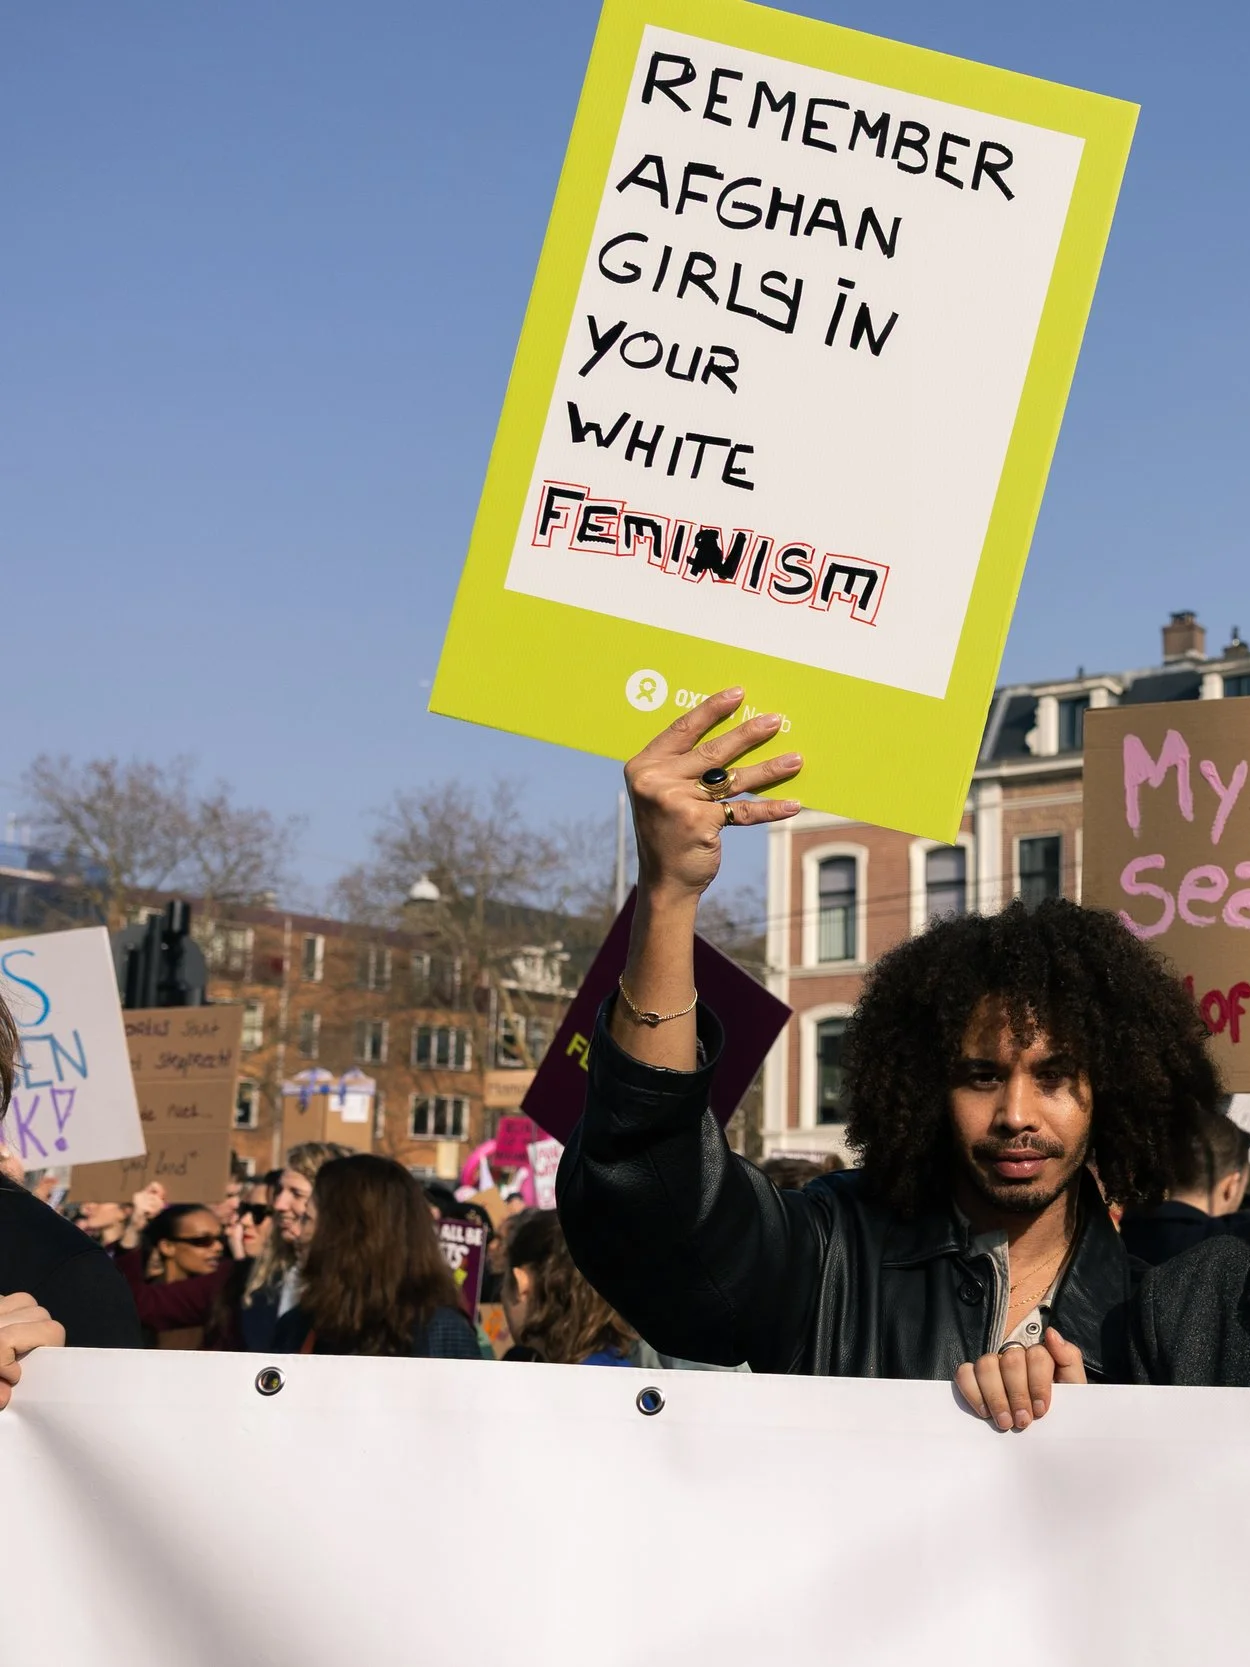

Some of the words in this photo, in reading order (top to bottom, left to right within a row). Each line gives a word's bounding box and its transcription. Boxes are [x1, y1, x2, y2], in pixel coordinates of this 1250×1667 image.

[641, 51, 1015, 201] REMEMBER
[616, 154, 902, 259] AFGHAN
[577, 315, 740, 394] YOUR
[567, 401, 754, 491] WHITE
[1123, 729, 1247, 844] My
[441, 1223, 464, 1243] ALL
[464, 1226, 483, 1247] BE
